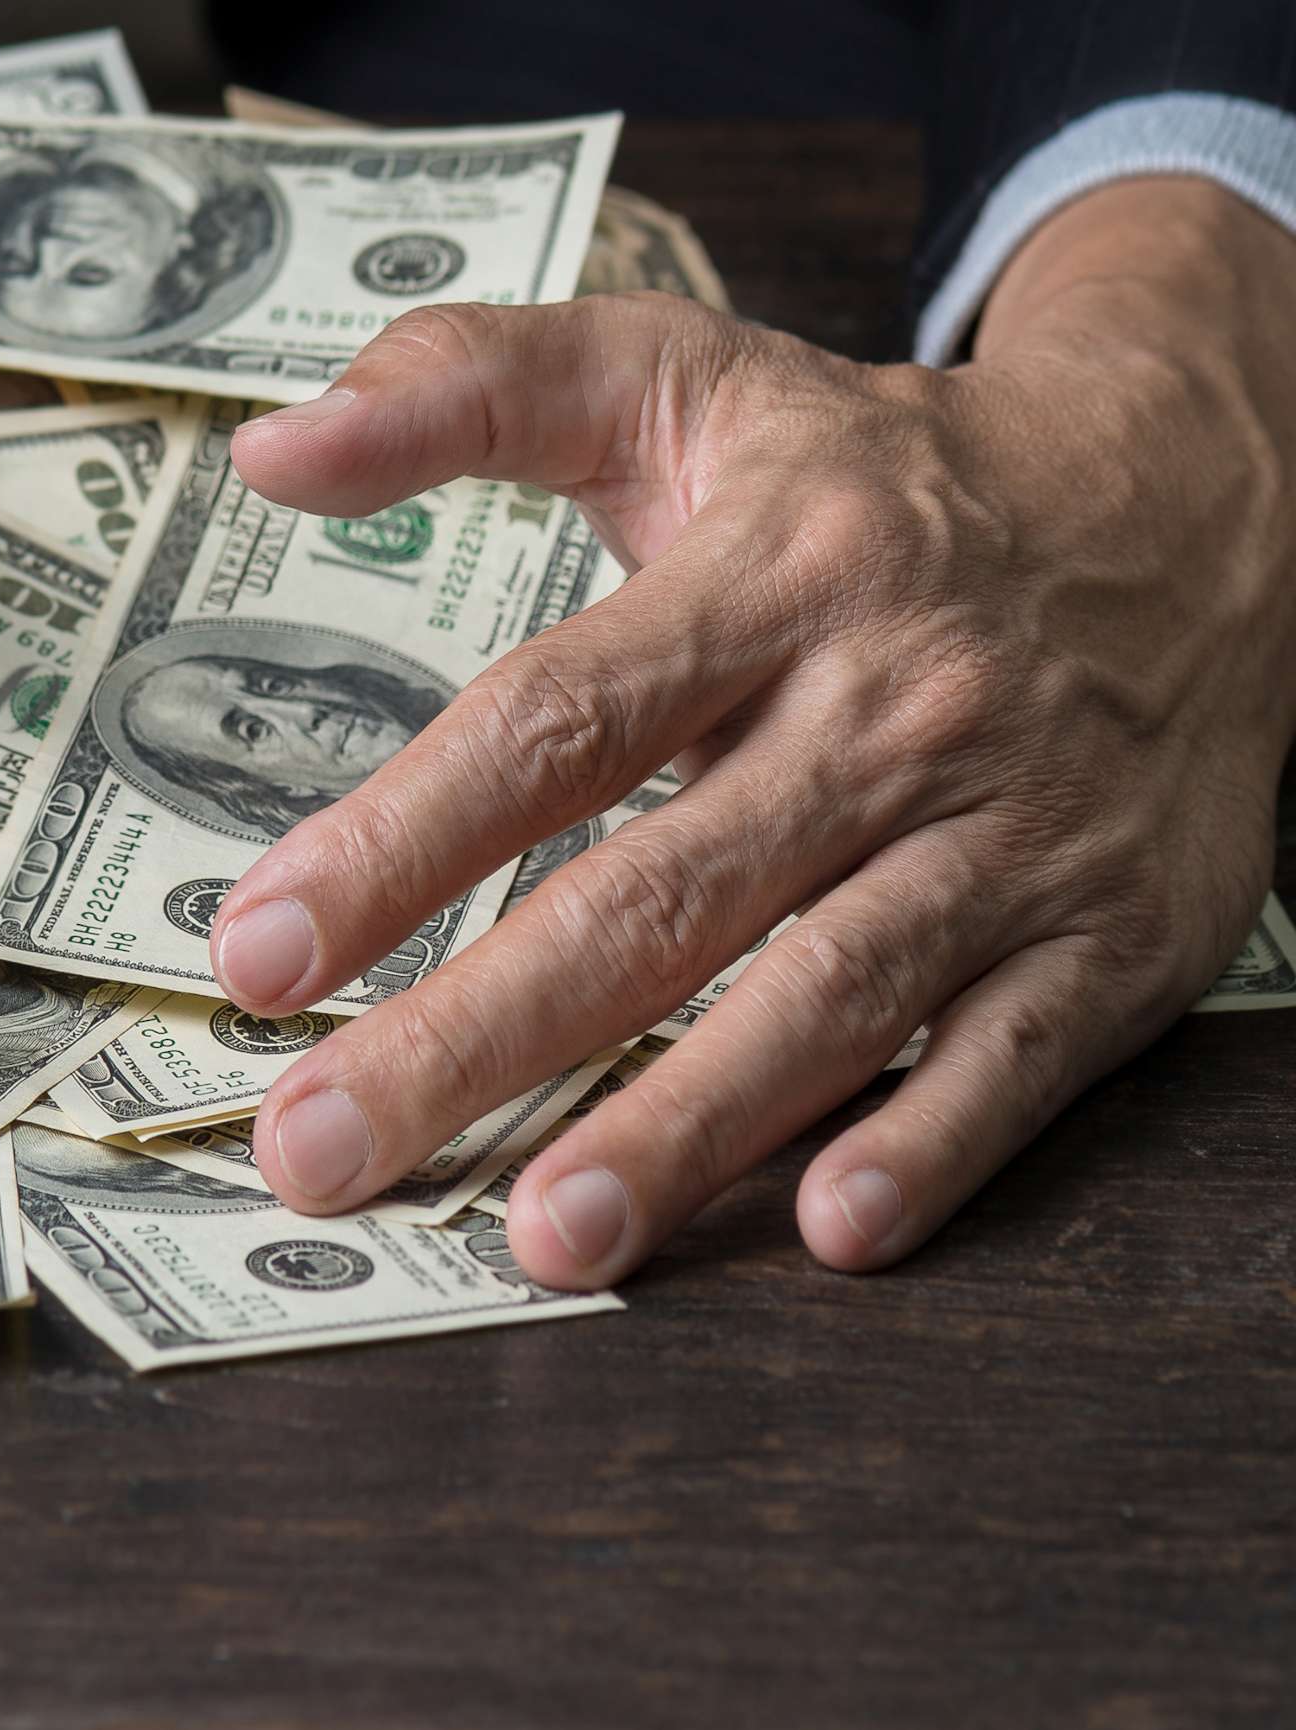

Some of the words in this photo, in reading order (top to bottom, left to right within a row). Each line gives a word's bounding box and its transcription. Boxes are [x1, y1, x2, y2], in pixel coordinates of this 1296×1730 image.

[38, 884, 74, 940] FEDERAL
[67, 818, 105, 887] RESERVE
[97, 782, 122, 821] NOTE
[104, 931, 137, 953] H8
[44, 1019, 91, 1055] FRANKLIN
[123, 1058, 169, 1104] FEDERAL
[216, 1069, 256, 1090] F6
